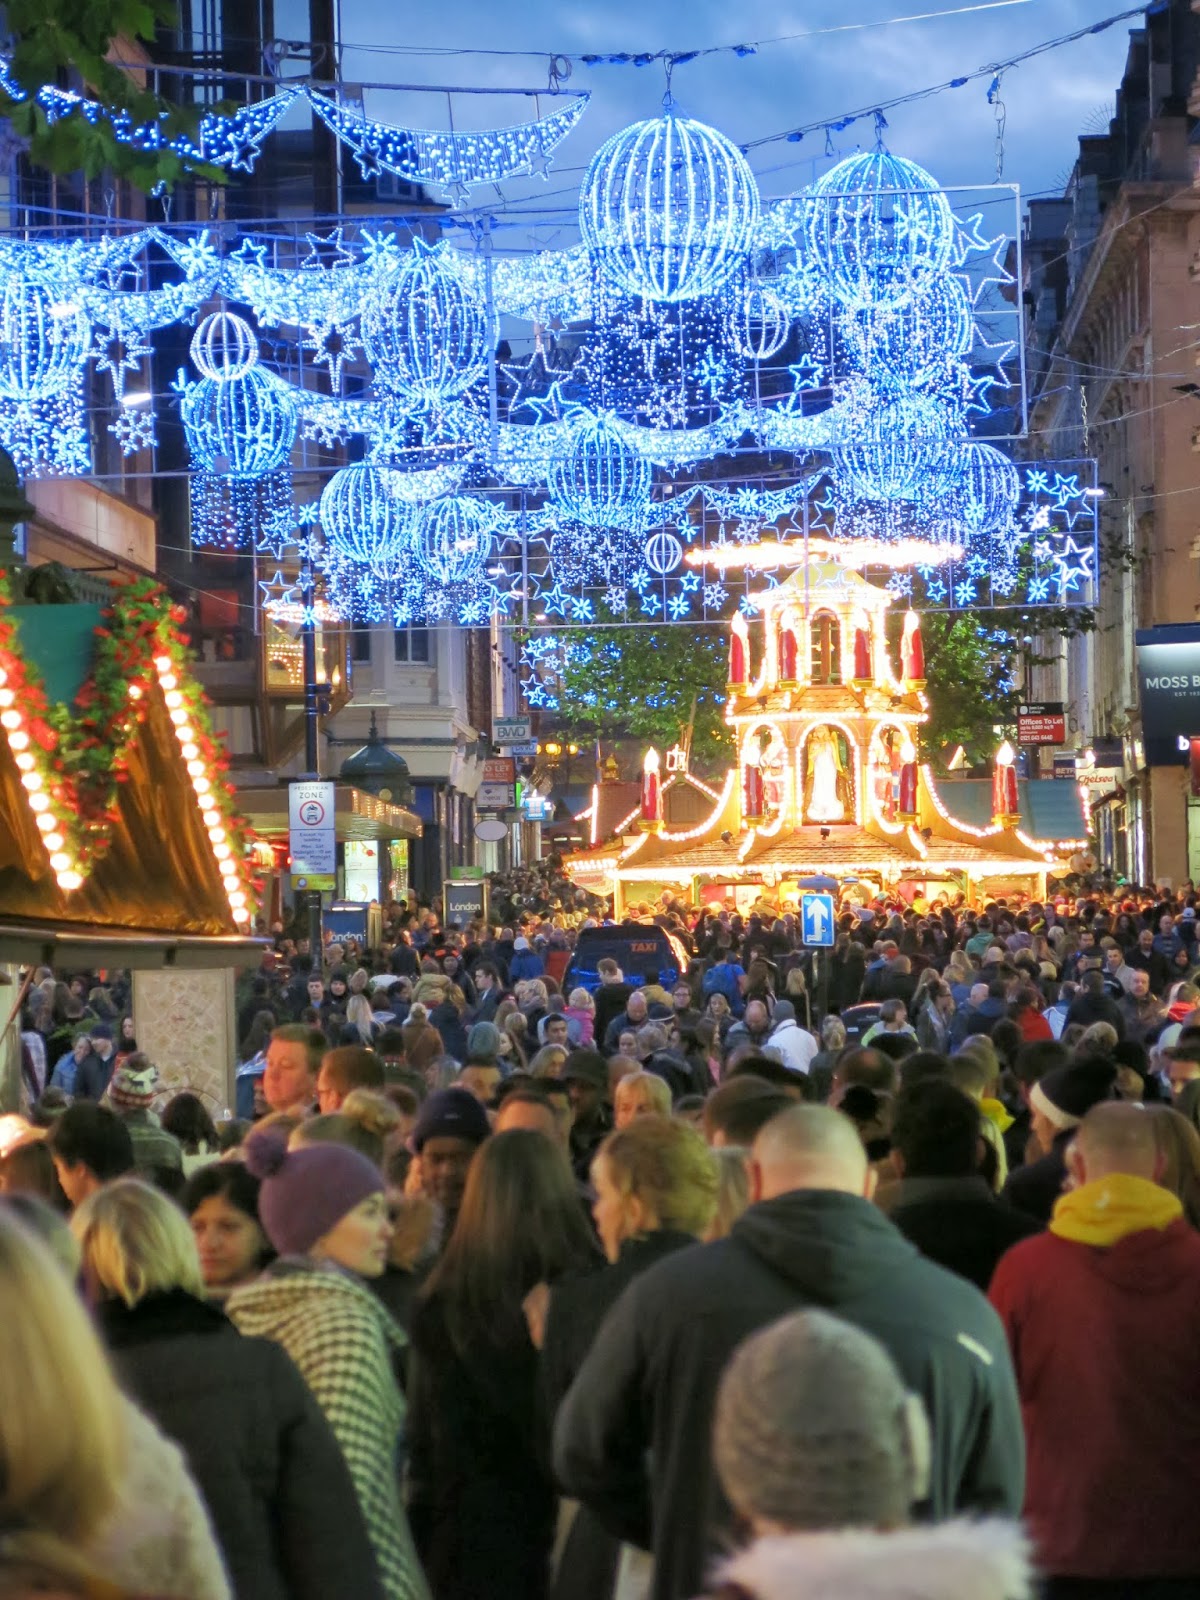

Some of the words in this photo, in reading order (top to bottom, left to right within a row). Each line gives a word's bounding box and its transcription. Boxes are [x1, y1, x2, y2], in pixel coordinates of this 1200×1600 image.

[1145, 676, 1189, 689] MOSS
[497, 727, 525, 737] BWD
[450, 902, 481, 911] London
[331, 931, 363, 943] ondon
[631, 942, 657, 952] TAXI
